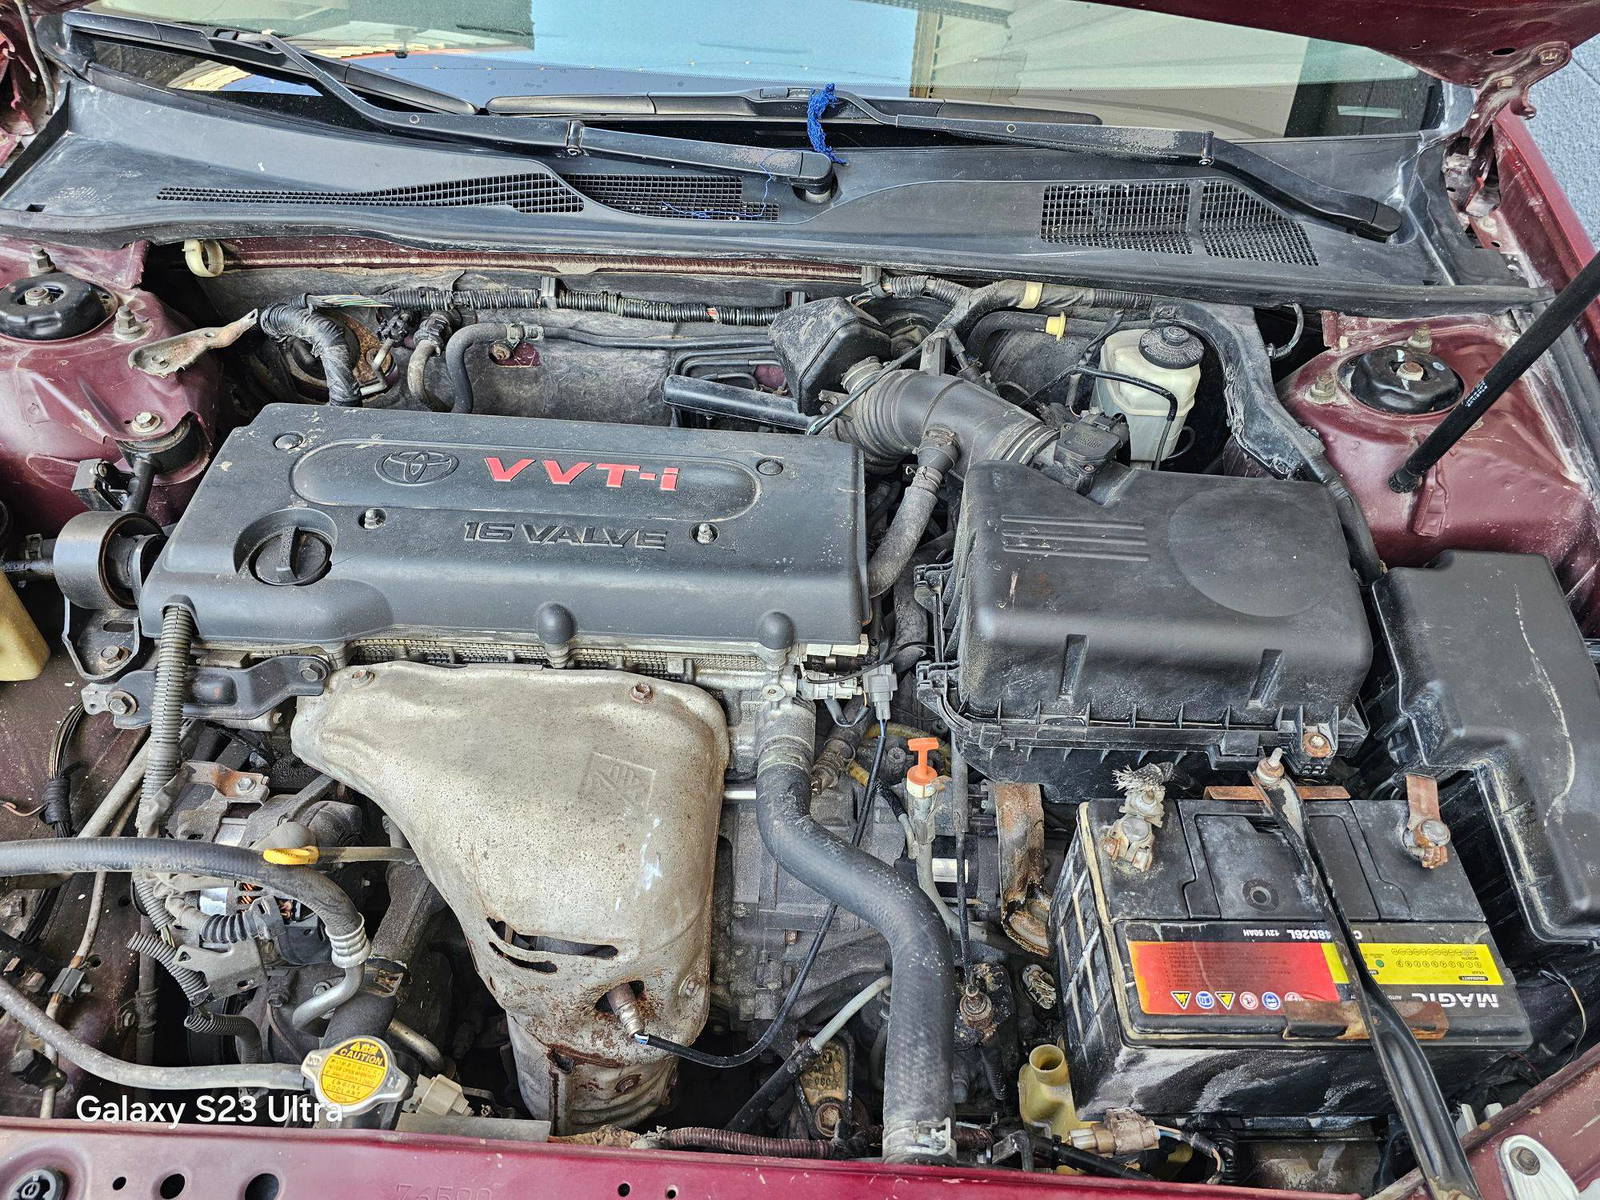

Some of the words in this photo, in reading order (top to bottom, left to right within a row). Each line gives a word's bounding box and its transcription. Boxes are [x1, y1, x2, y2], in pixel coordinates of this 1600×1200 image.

[484, 457, 680, 491] VVT-i
[464, 522, 515, 541] 16
[521, 524, 668, 550] VALVE
[1265, 929, 1280, 937] 12V
[340, 1048, 384, 1066] CAUTION
